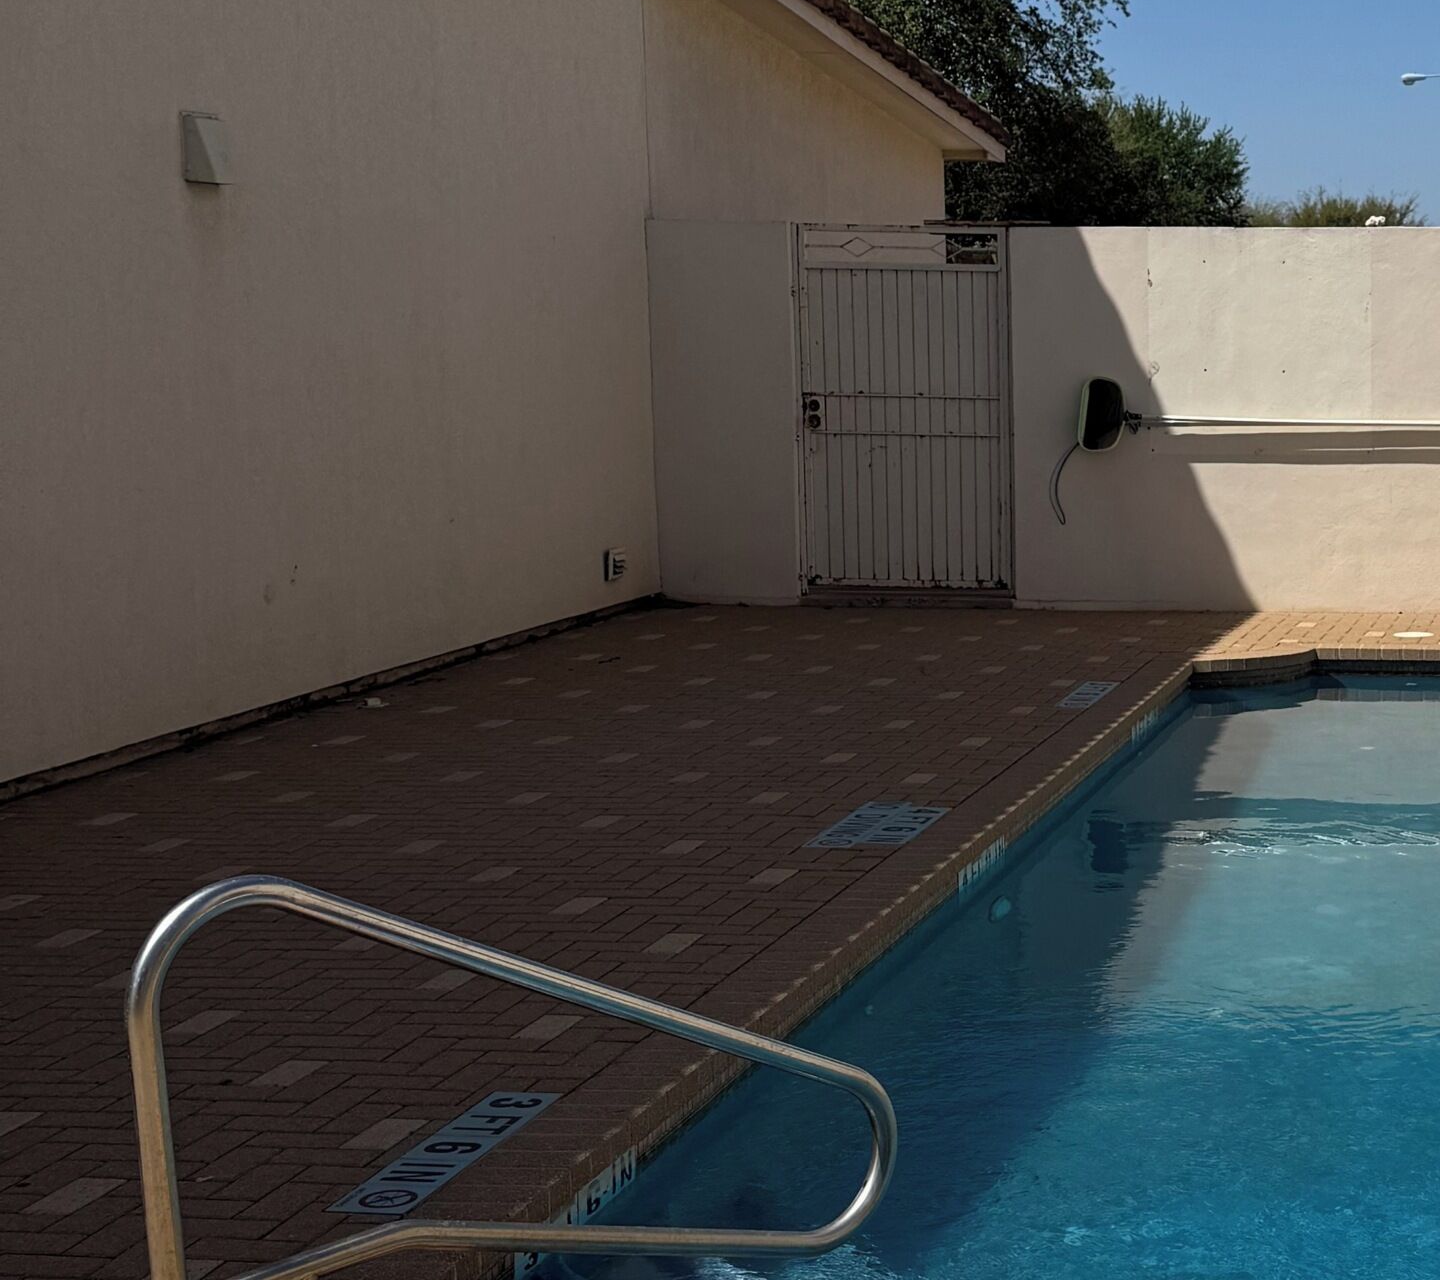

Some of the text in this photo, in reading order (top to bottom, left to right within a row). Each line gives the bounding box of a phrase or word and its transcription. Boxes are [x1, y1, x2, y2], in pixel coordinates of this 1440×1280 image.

[380, 1097, 543, 1183] 3 FT 6 IN
